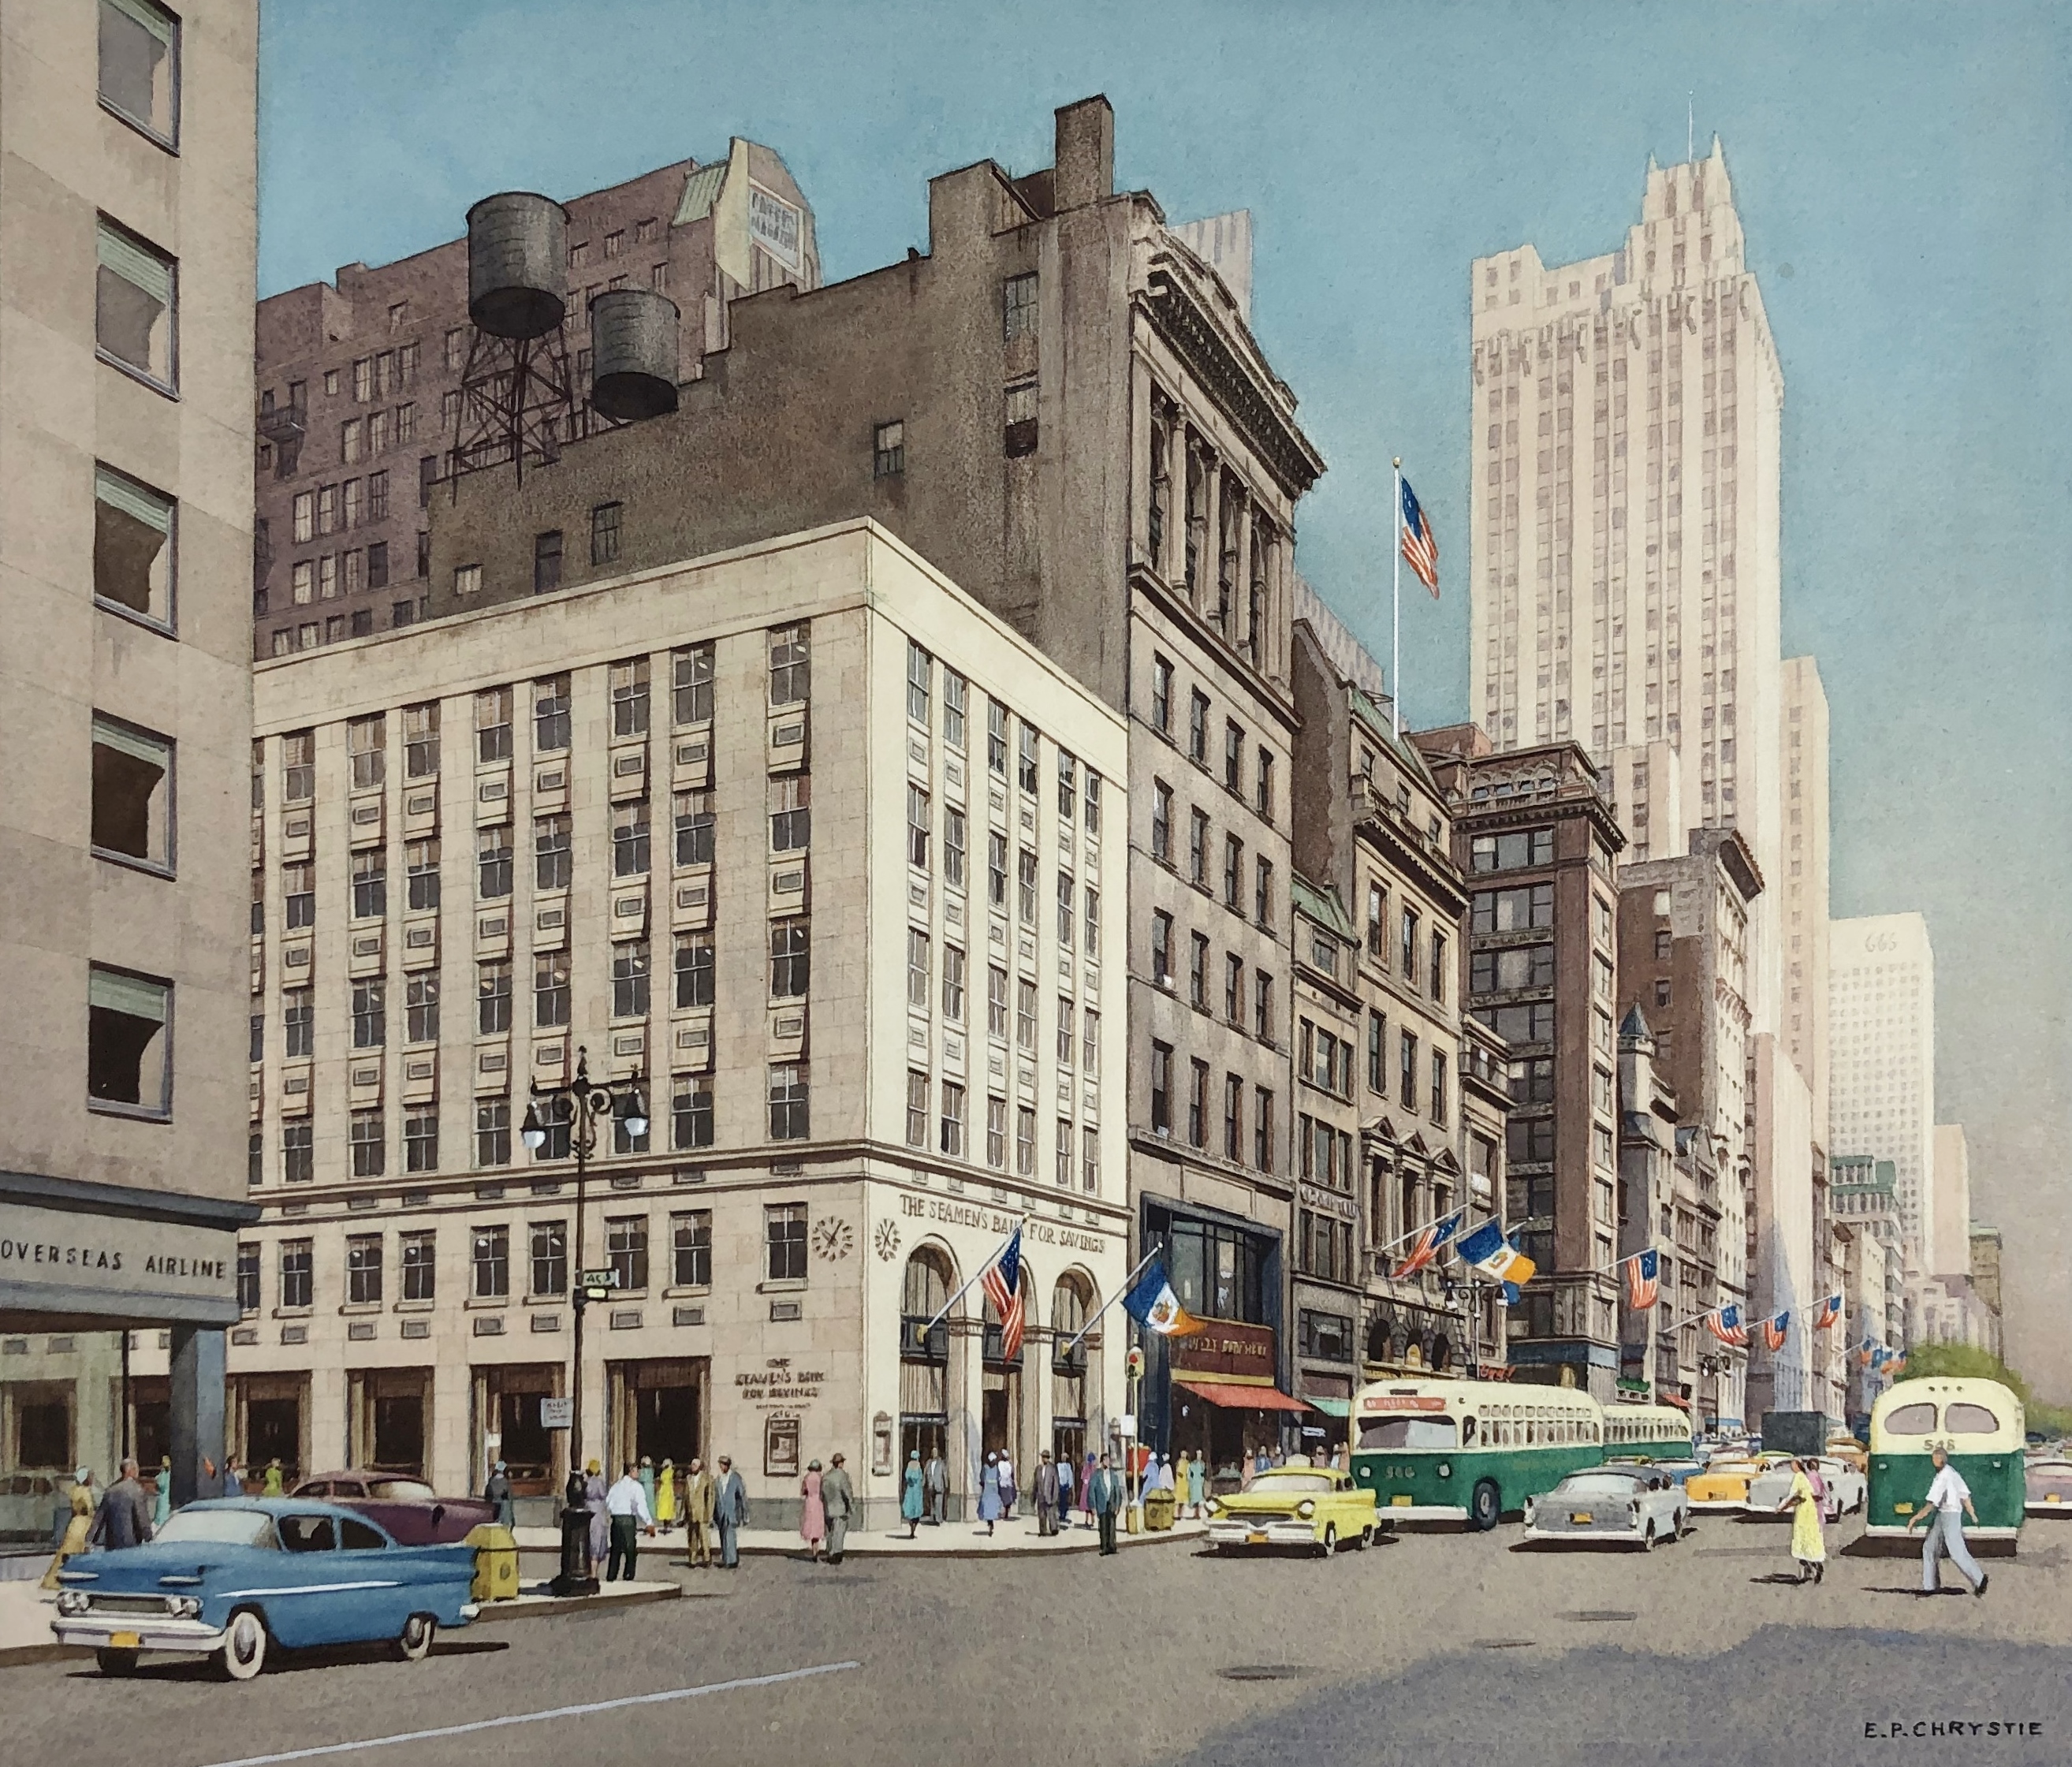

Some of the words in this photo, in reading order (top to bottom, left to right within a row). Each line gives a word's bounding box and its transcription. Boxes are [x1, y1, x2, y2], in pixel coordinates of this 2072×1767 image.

[900, 1194, 925, 1217] THE
[930, 1201, 987, 1229] SEAMEN'S
[1030, 1223, 1056, 1244] FOR
[1060, 1230, 1105, 1254] SAVINGS
[1, 1239, 122, 1271] OVERSEAS
[145, 1255, 225, 1280] AIRLINE
